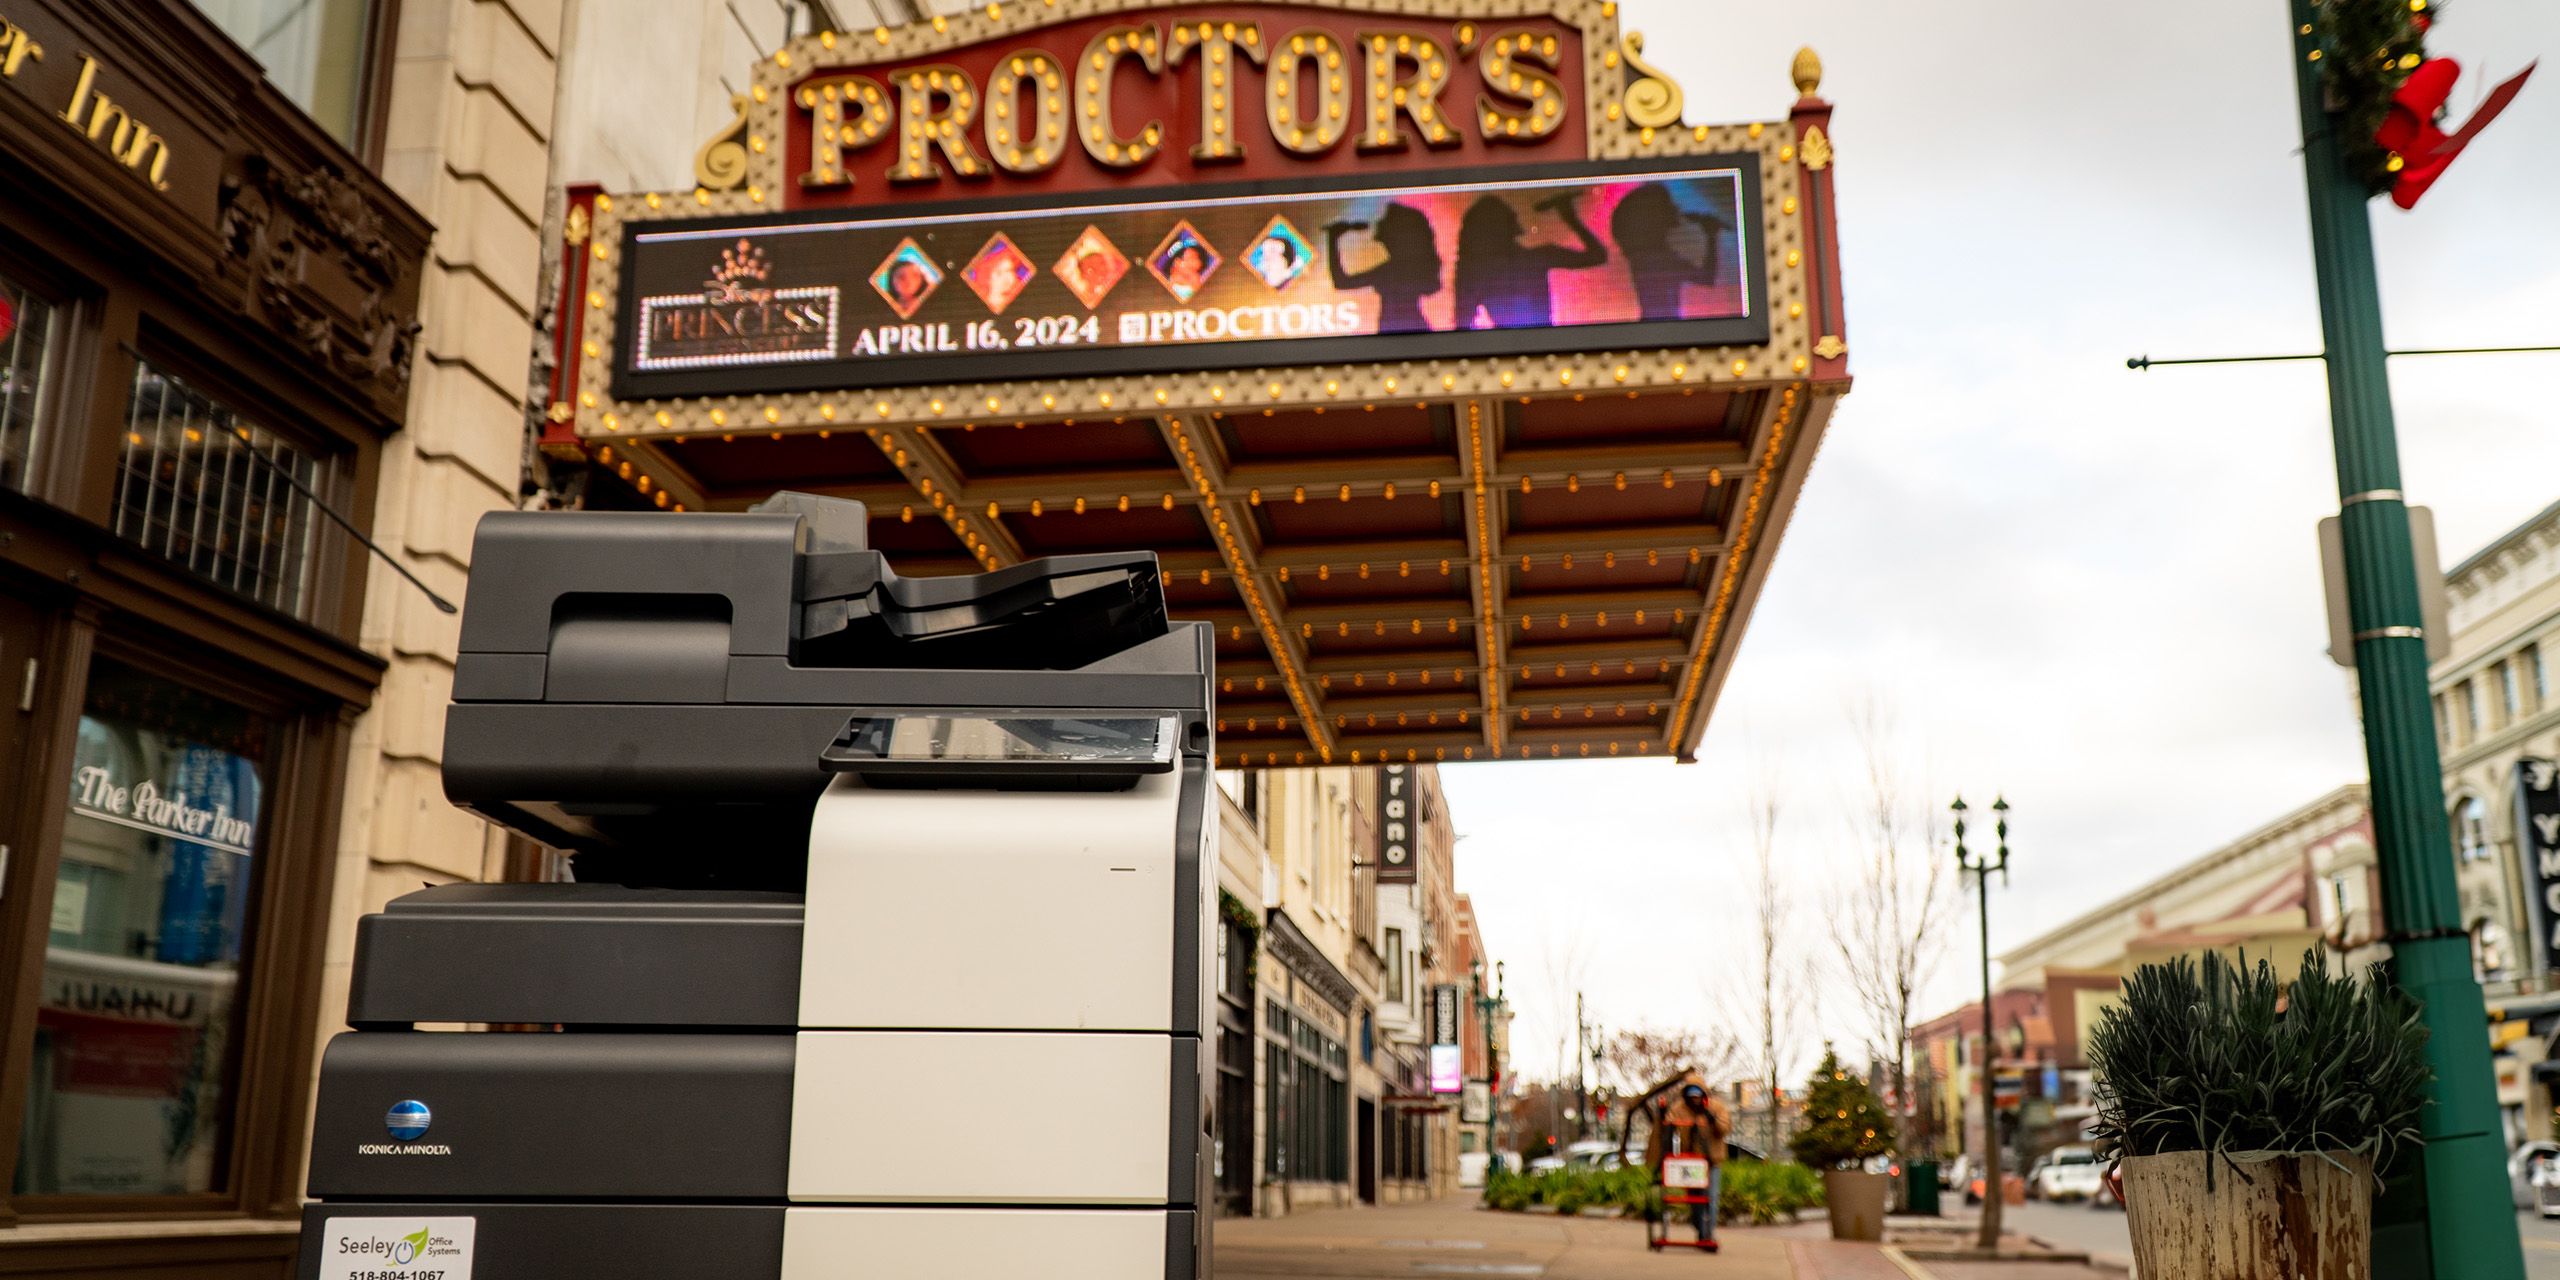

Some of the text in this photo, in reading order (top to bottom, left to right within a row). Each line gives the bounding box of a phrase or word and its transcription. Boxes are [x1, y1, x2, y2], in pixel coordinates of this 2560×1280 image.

[795, 19, 1567, 186] PROCTOR'S
[57, 51, 171, 192] Inn
[852, 322, 959, 356] APRIL
[1015, 314, 1099, 347] 2024
[1150, 301, 1360, 341] PROCTORS
[77, 766, 252, 847] The Parker Inn
[358, 1144, 451, 1155] KONICA MINOLTA
[339, 1236, 395, 1258] Seeley
[427, 1247, 461, 1258] Systems
[428, 1237, 453, 1246] Office
[349, 1270, 445, 1280] 518-804-1067
